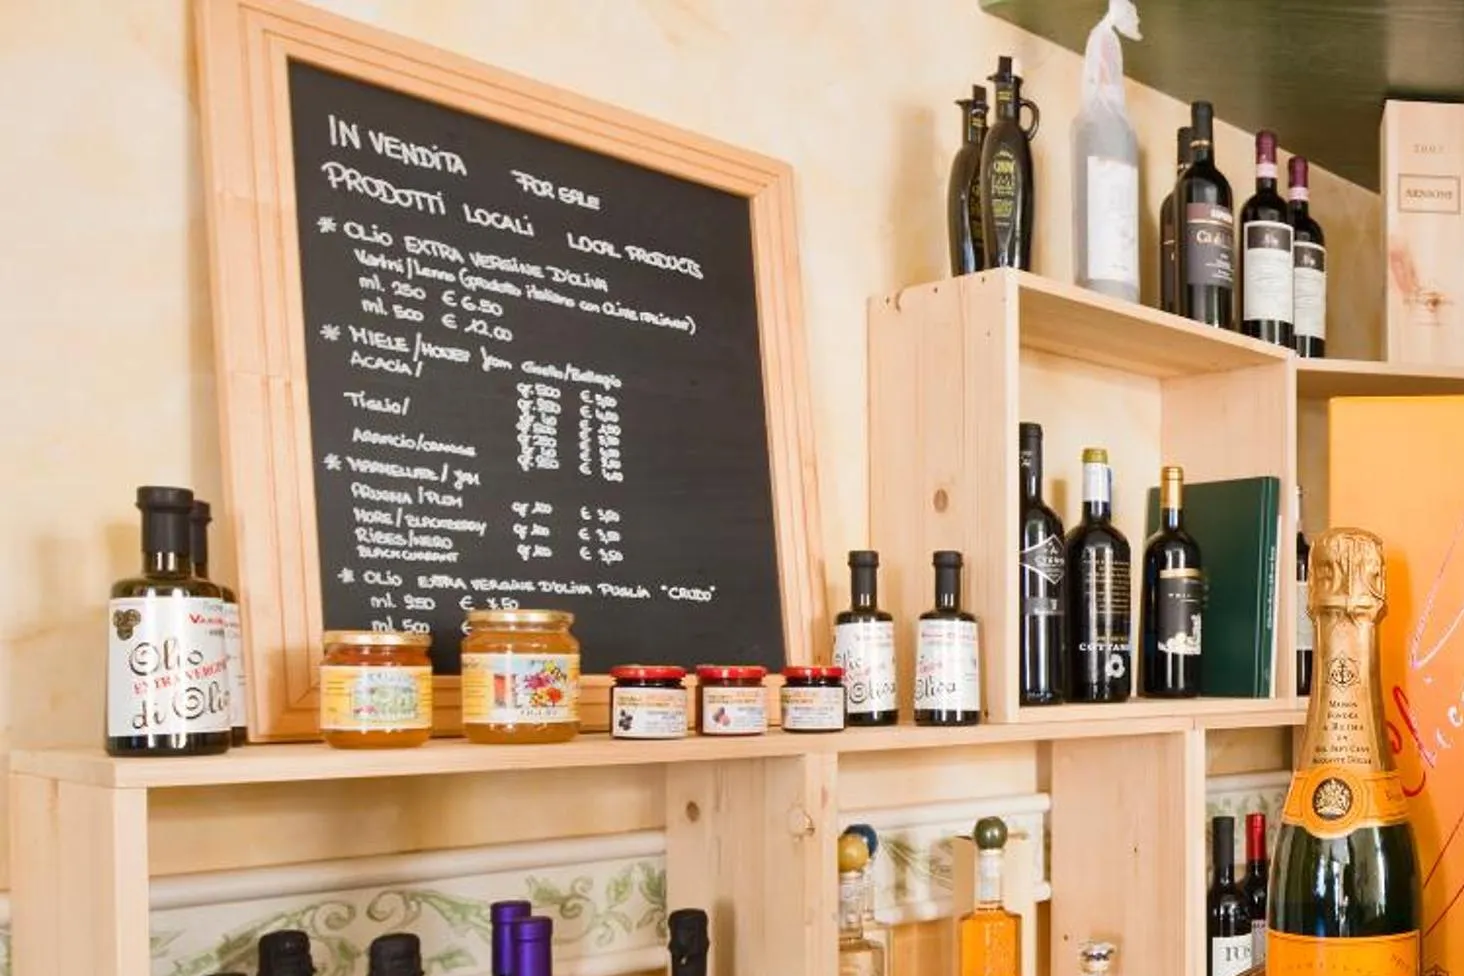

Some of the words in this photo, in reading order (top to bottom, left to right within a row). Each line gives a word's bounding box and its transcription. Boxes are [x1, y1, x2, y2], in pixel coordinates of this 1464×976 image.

[328, 114, 361, 149] IN
[510, 170, 555, 199] FOR
[404, 236, 465, 263] EXTRA
[566, 232, 622, 258] LOCAL
[624, 245, 704, 280] PRODUCTS
[441, 290, 457, 307] €
[441, 313, 457, 329] €
[459, 595, 475, 611] €
